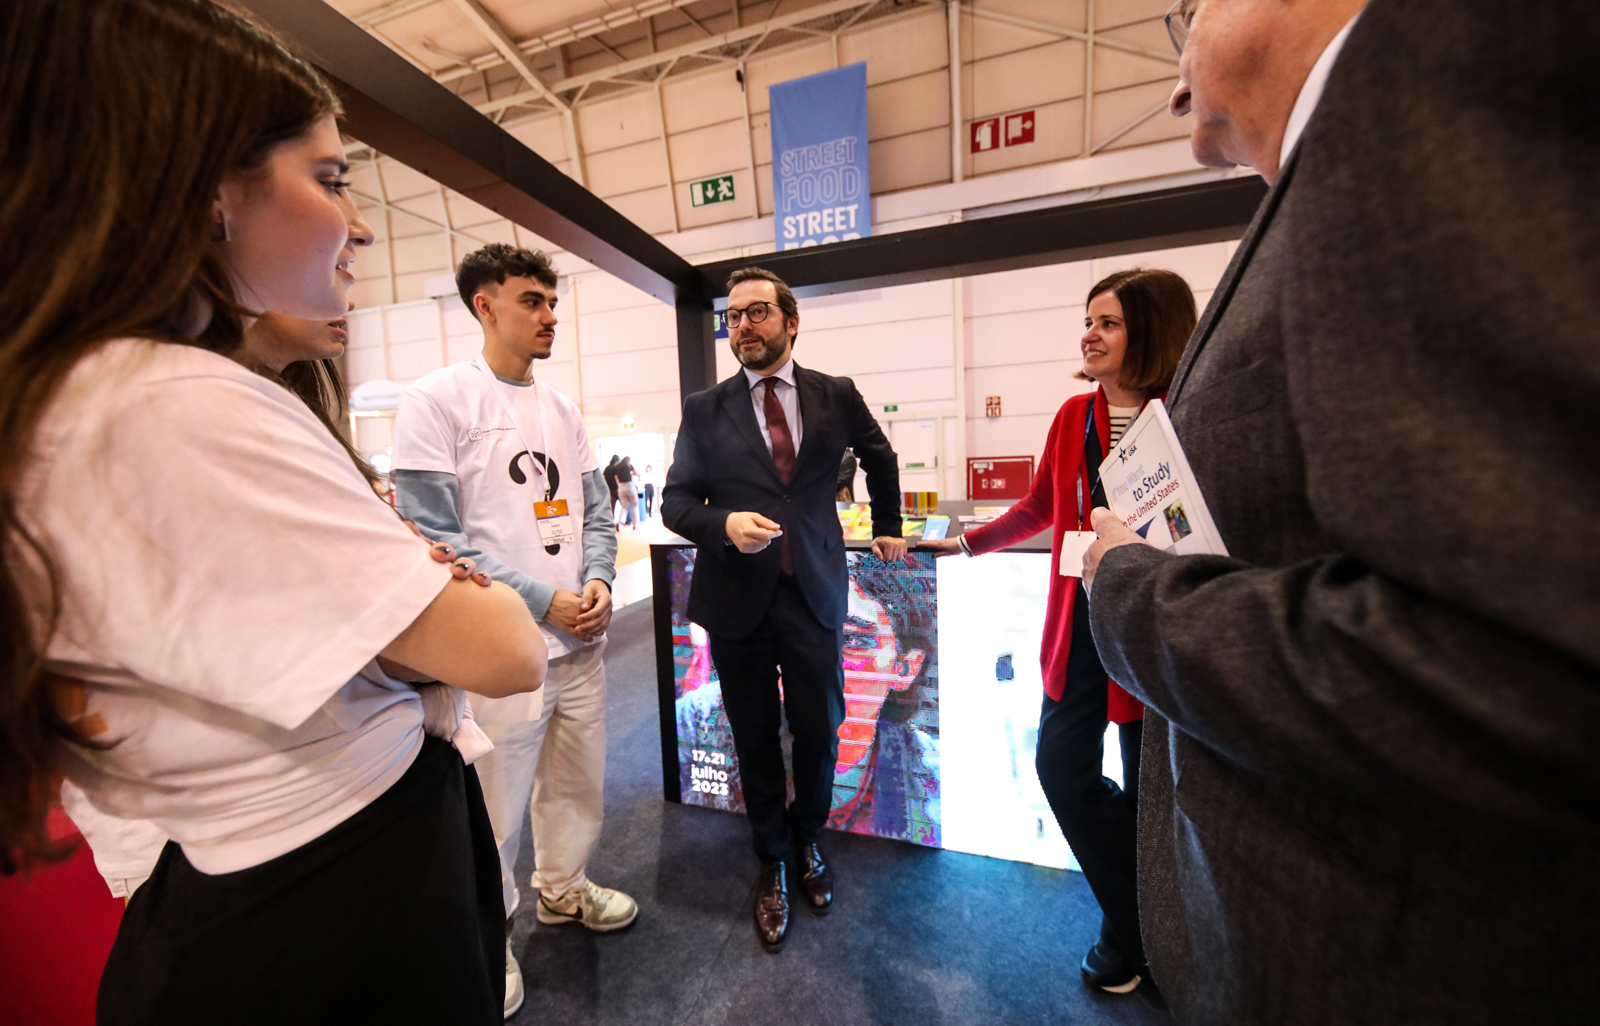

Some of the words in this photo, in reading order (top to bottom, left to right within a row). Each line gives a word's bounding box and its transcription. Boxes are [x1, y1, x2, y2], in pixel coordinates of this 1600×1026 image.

[781, 137, 858, 178] STREET
[782, 166, 861, 212] FOOD
[783, 204, 859, 239] STREET
[1128, 445, 1138, 456] USA
[1132, 487, 1144, 502] to
[1143, 461, 1171, 494] Study
[1126, 513, 1138, 526] the
[1136, 493, 1158, 518] United
[1156, 478, 1180, 502] States
[690, 764, 728, 782] julho
[691, 749, 726, 765] 17.21
[692, 779, 729, 796] 2023
